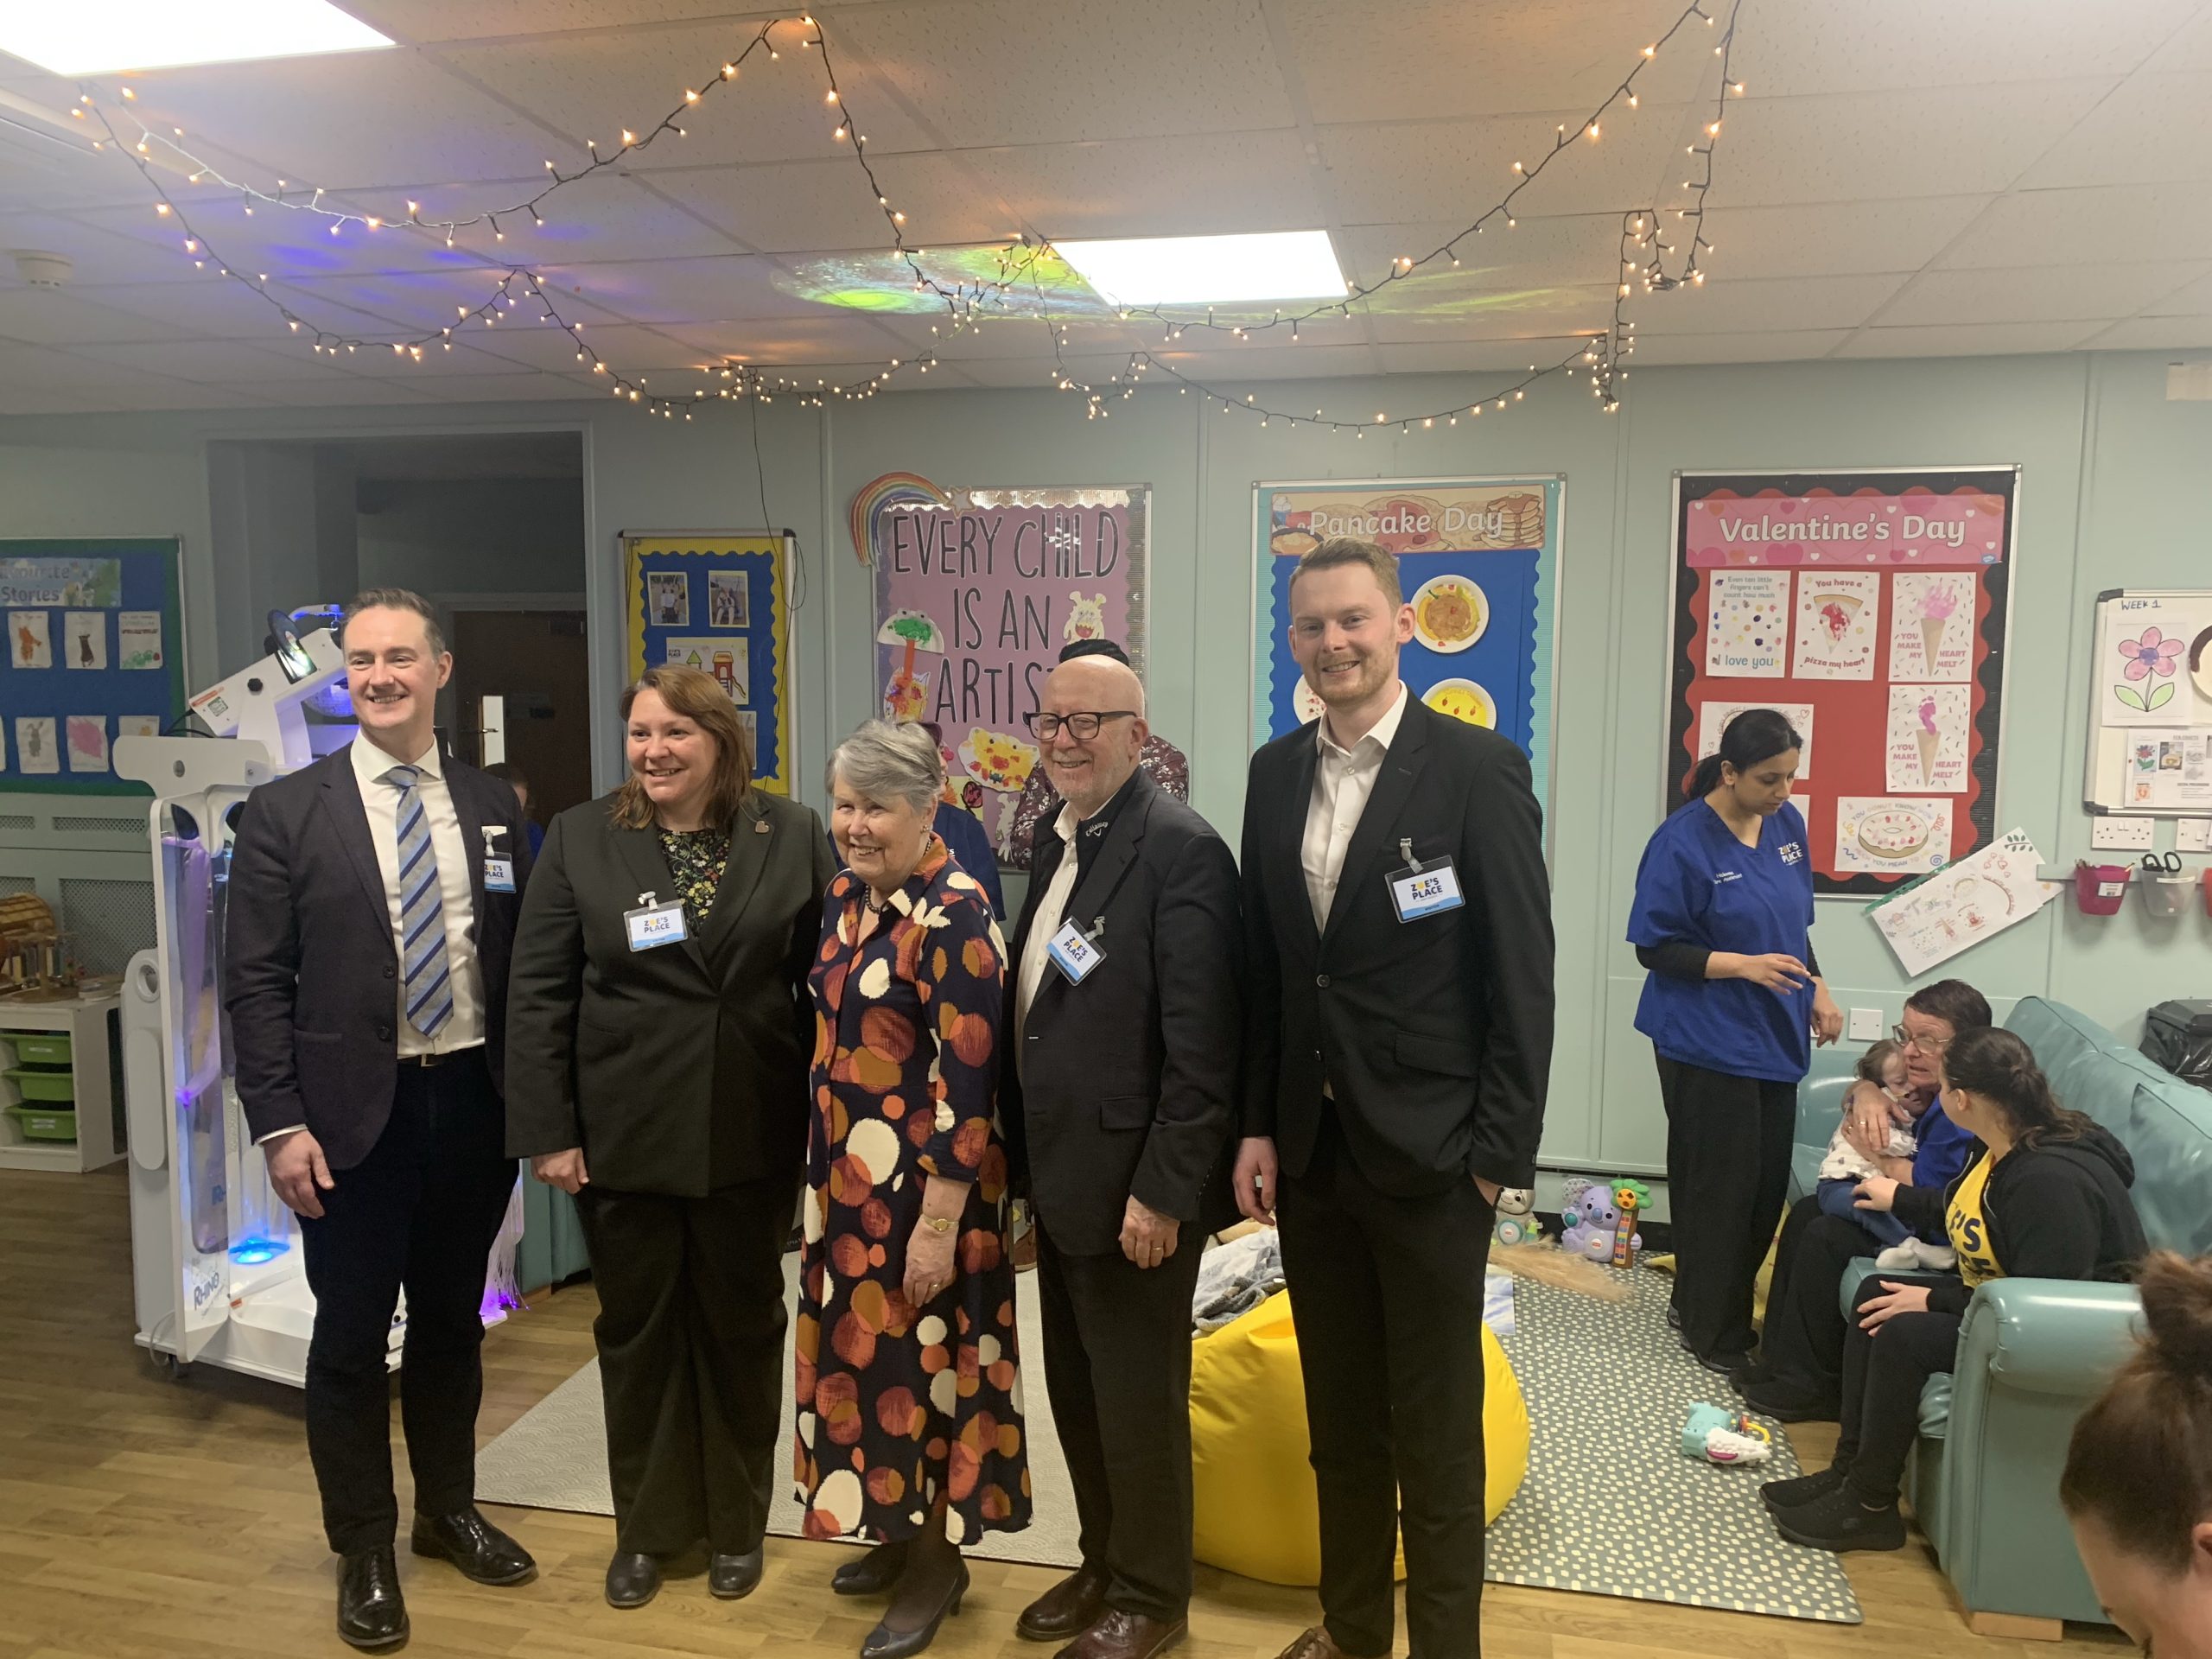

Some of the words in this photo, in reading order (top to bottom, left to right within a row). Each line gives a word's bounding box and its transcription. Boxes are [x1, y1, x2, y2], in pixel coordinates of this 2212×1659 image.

[1309, 506, 1431, 536] Pancake
[1445, 507, 1503, 539] Day
[1718, 513, 1891, 542] Valentine's
[1902, 515, 1966, 547] Day
[893, 513, 1002, 578] EVERY
[1014, 512, 1119, 578] CHILD
[1834, 578, 1854, 587] have
[2, 586, 60, 601] Stories
[2121, 600, 2148, 611] WEEK
[2152, 600, 2163, 608] 1
[953, 588, 982, 650] IS
[998, 589, 1051, 651] AN
[1725, 655, 1748, 665] love
[1752, 658, 1774, 670] you
[1804, 656, 1827, 666] pizza
[1843, 658, 1866, 668] heart
[935, 658, 1054, 727] ARTIS
[1412, 885, 1443, 900] PLACE
[644, 923, 670, 933] PLACE
[1064, 941, 1084, 963] PLACE
